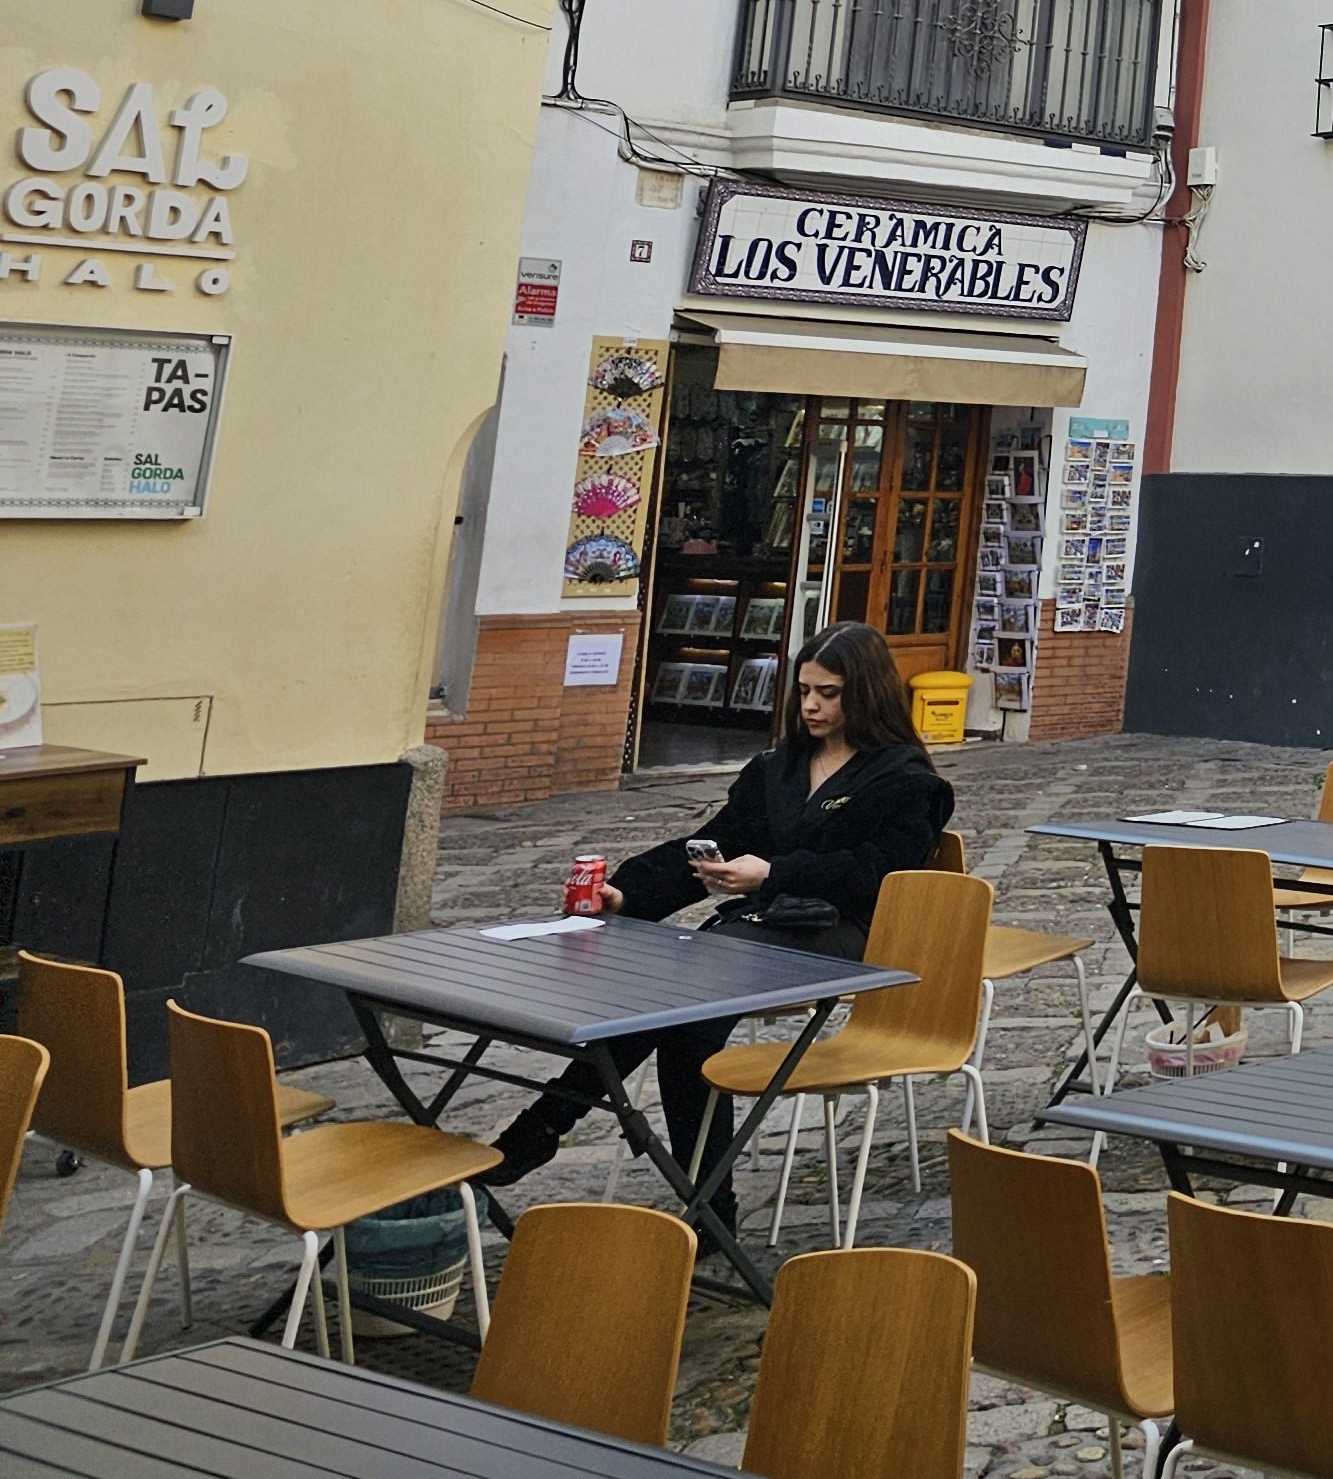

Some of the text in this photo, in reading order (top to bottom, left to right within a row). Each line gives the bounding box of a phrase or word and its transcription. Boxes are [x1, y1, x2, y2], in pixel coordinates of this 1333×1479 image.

[16, 67, 249, 191] SAL
[4, 177, 235, 245] GORDA
[637, 245, 645, 257] 7
[0, 252, 230, 296] HALO
[520, 272, 559, 281] verisure
[713, 234, 1066, 305] LOS VENERABLES
[518, 285, 557, 297] Alarma
[143, 386, 209, 413] PAS
[134, 453, 162, 466] SAL
[131, 467, 185, 481] GORDA
[128, 480, 172, 494] HALO
